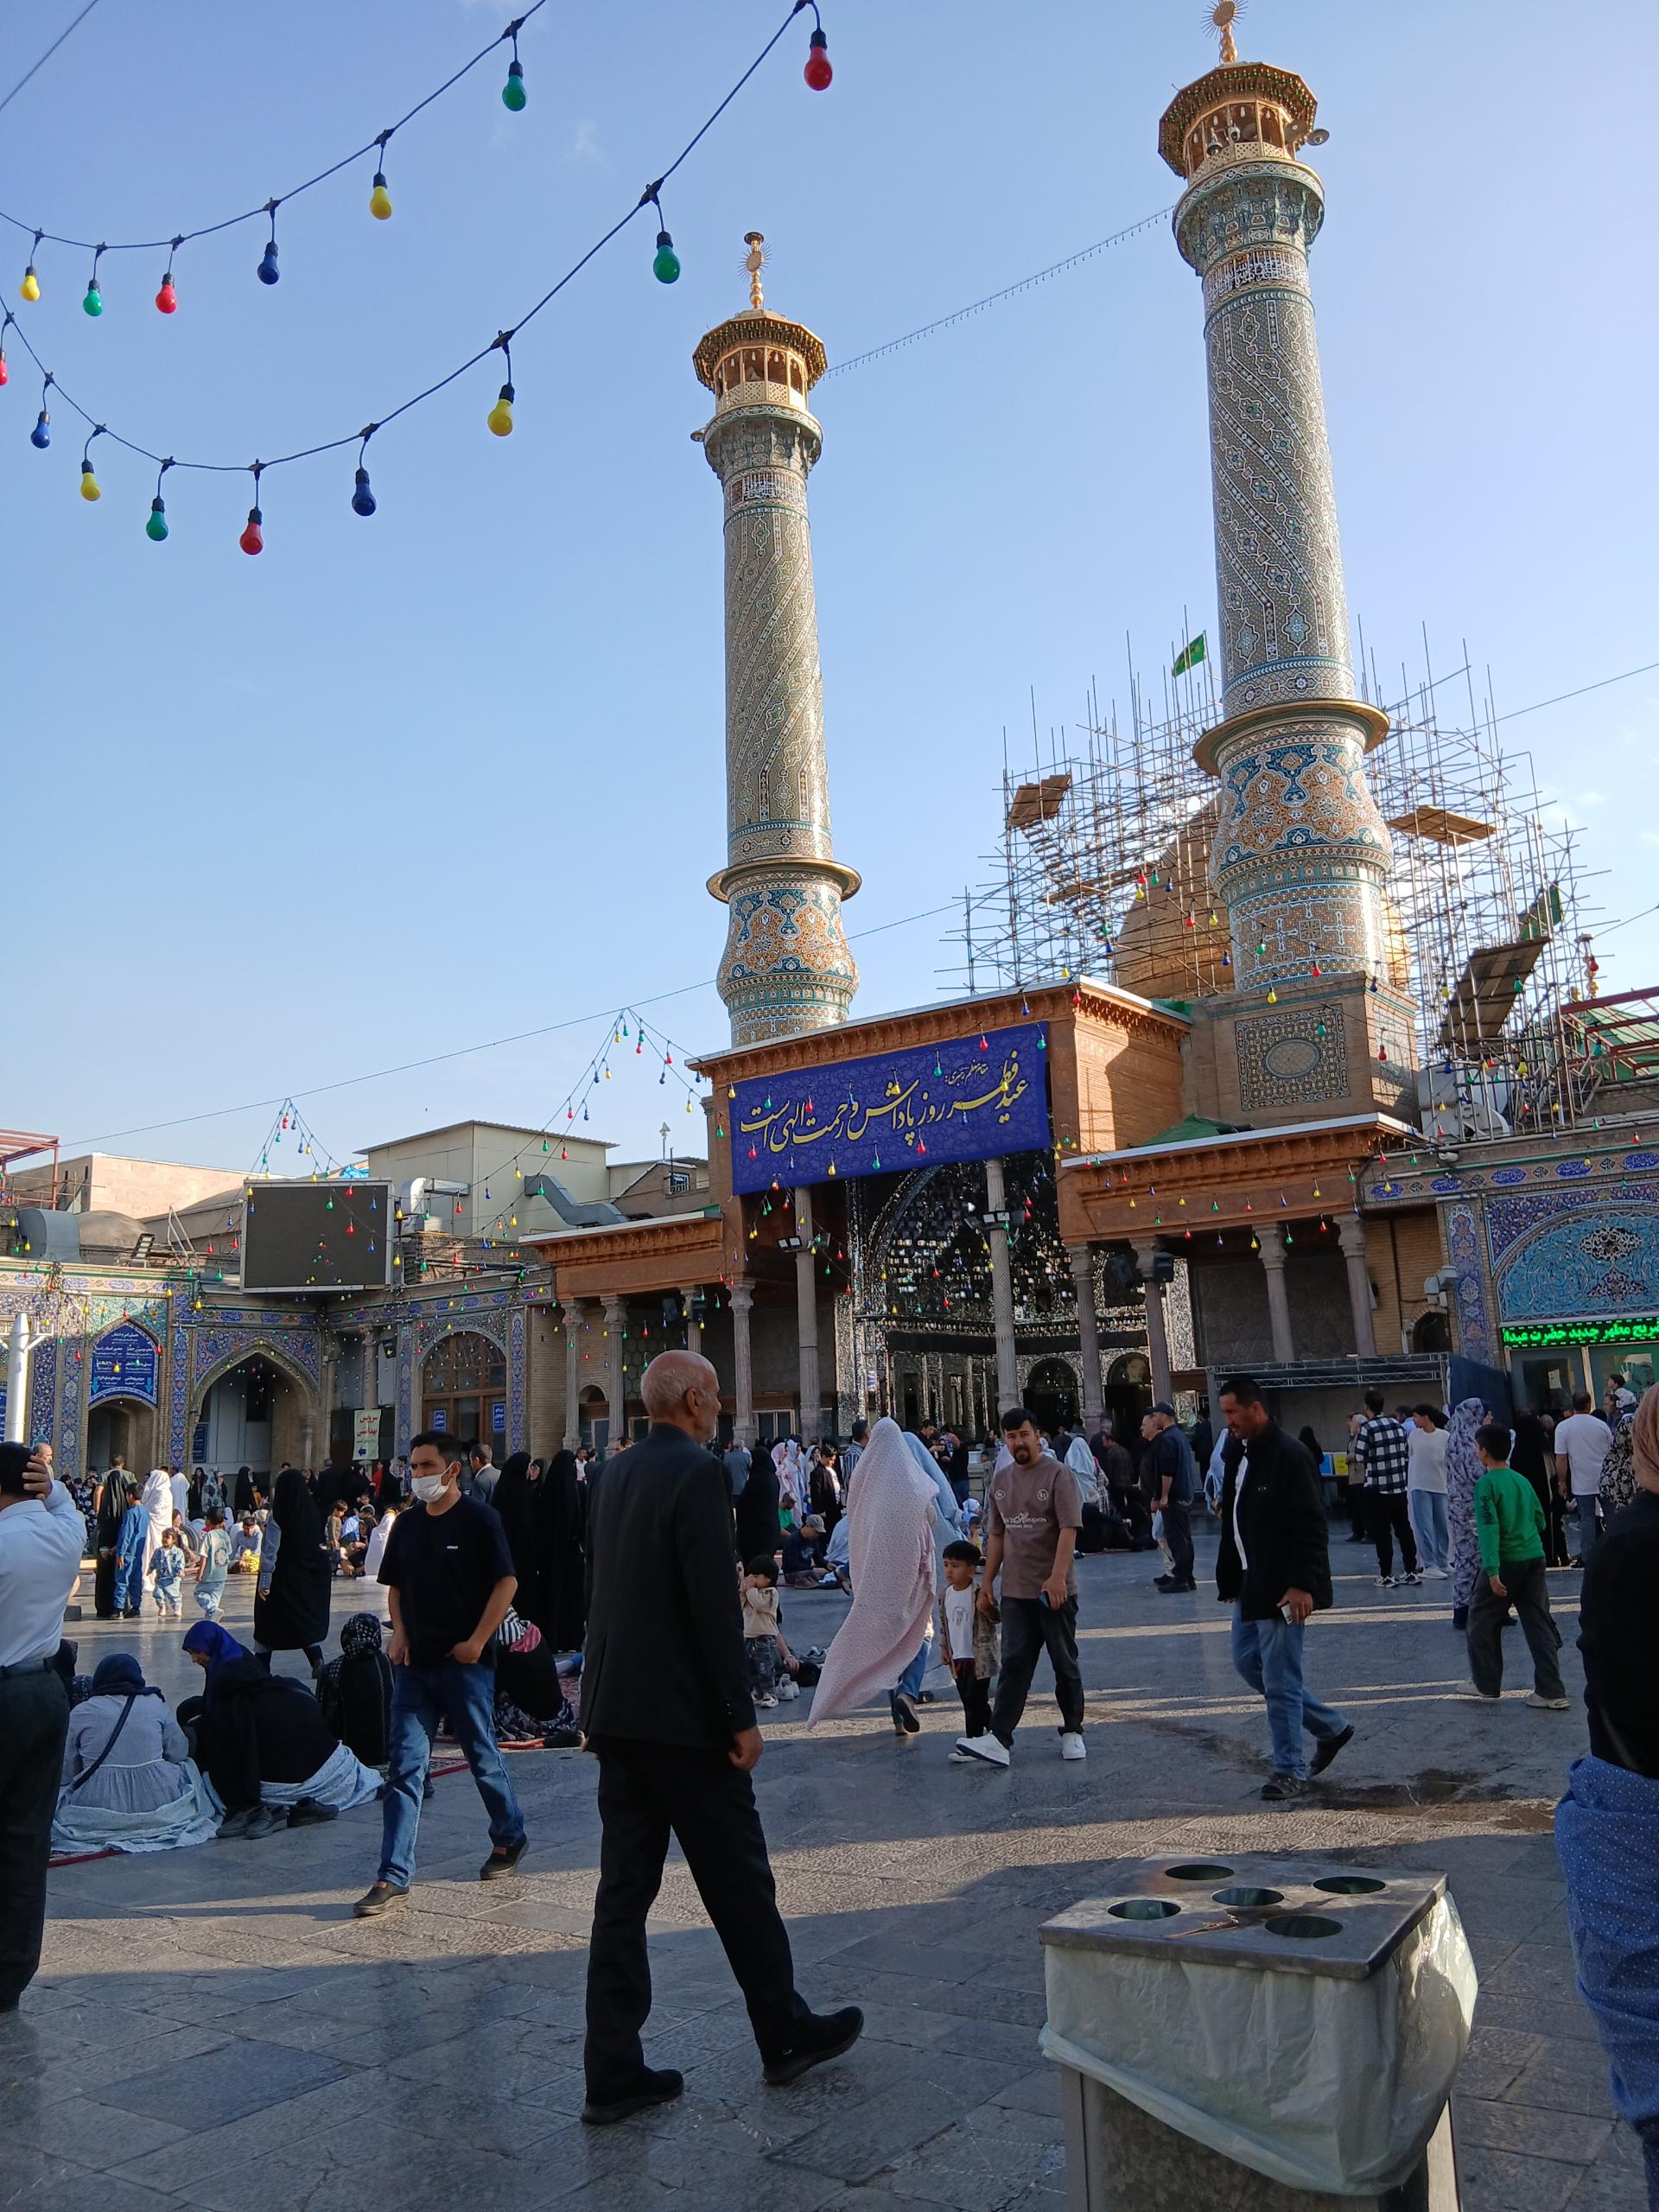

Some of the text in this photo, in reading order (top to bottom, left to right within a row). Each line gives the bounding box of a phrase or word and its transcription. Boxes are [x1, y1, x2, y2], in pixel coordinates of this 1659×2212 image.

[946, 1050, 1020, 1120] فطر
[995, 1079, 1029, 1125] عید
[741, 1099, 791, 1148] است
[769, 1102, 805, 1153] الهی
[792, 1103, 849, 1144] رحمت
[847, 1078, 920, 1147] پاداش
[918, 1092, 946, 1127] روز
[1529, 1326, 1567, 1344] حضرت
[1568, 1327, 1599, 1342] جدید
[1602, 1323, 1630, 1339] مطهر
